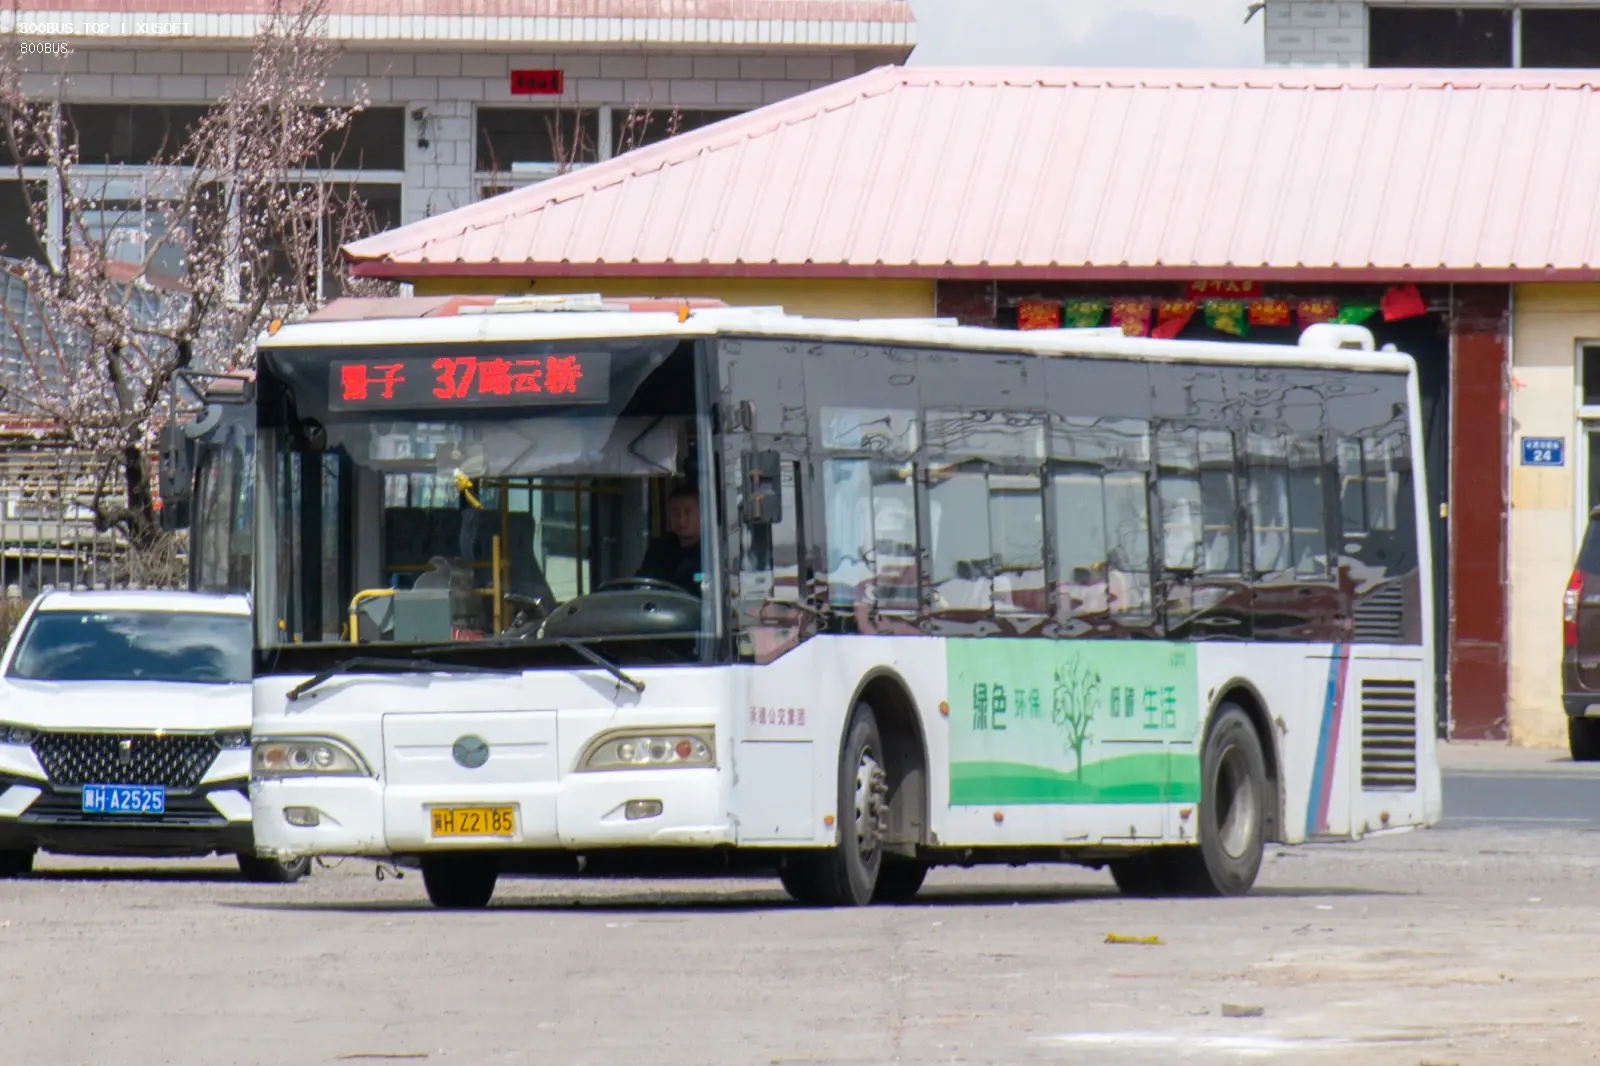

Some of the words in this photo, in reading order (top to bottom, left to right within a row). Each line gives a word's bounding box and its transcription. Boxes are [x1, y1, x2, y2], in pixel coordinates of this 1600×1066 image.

[1533, 449, 1552, 461] 24
[973, 682, 1007, 730] 绿色
[1014, 688, 1041, 719] 环保
[1142, 684, 1177, 729] 生活
